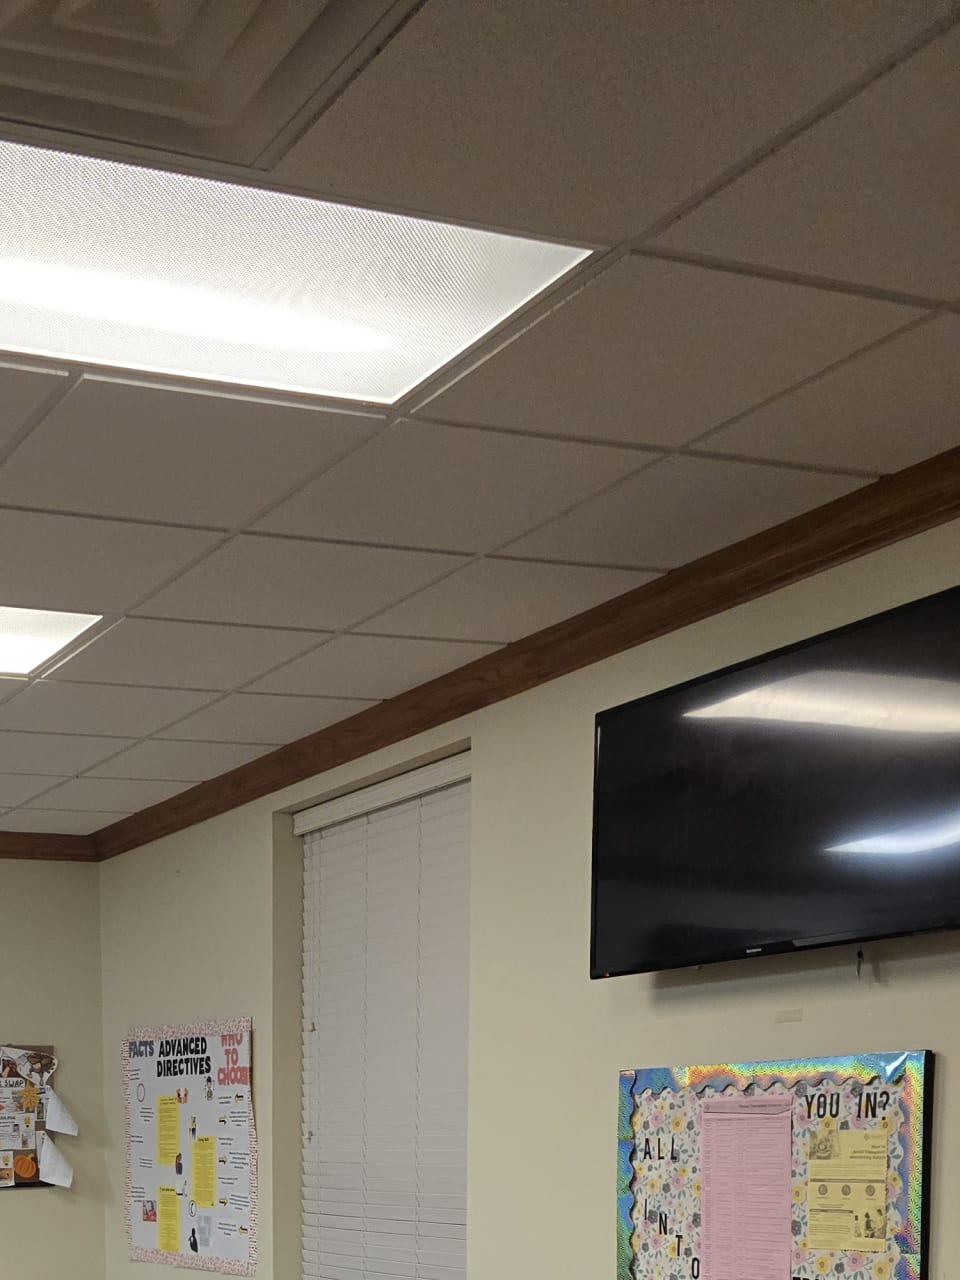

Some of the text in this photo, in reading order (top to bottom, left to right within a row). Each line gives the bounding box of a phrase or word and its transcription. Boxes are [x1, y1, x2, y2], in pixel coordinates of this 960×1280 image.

[128, 1040, 155, 1058] FACTS
[158, 1036, 208, 1058] ADVANCED
[224, 1047, 238, 1067] TO
[156, 1055, 212, 1078] DIRECTIVES
[4, 1079, 24, 1087] SWAP
[804, 1090, 890, 1121] YOU IN?
[643, 1137, 678, 1160] ALL
